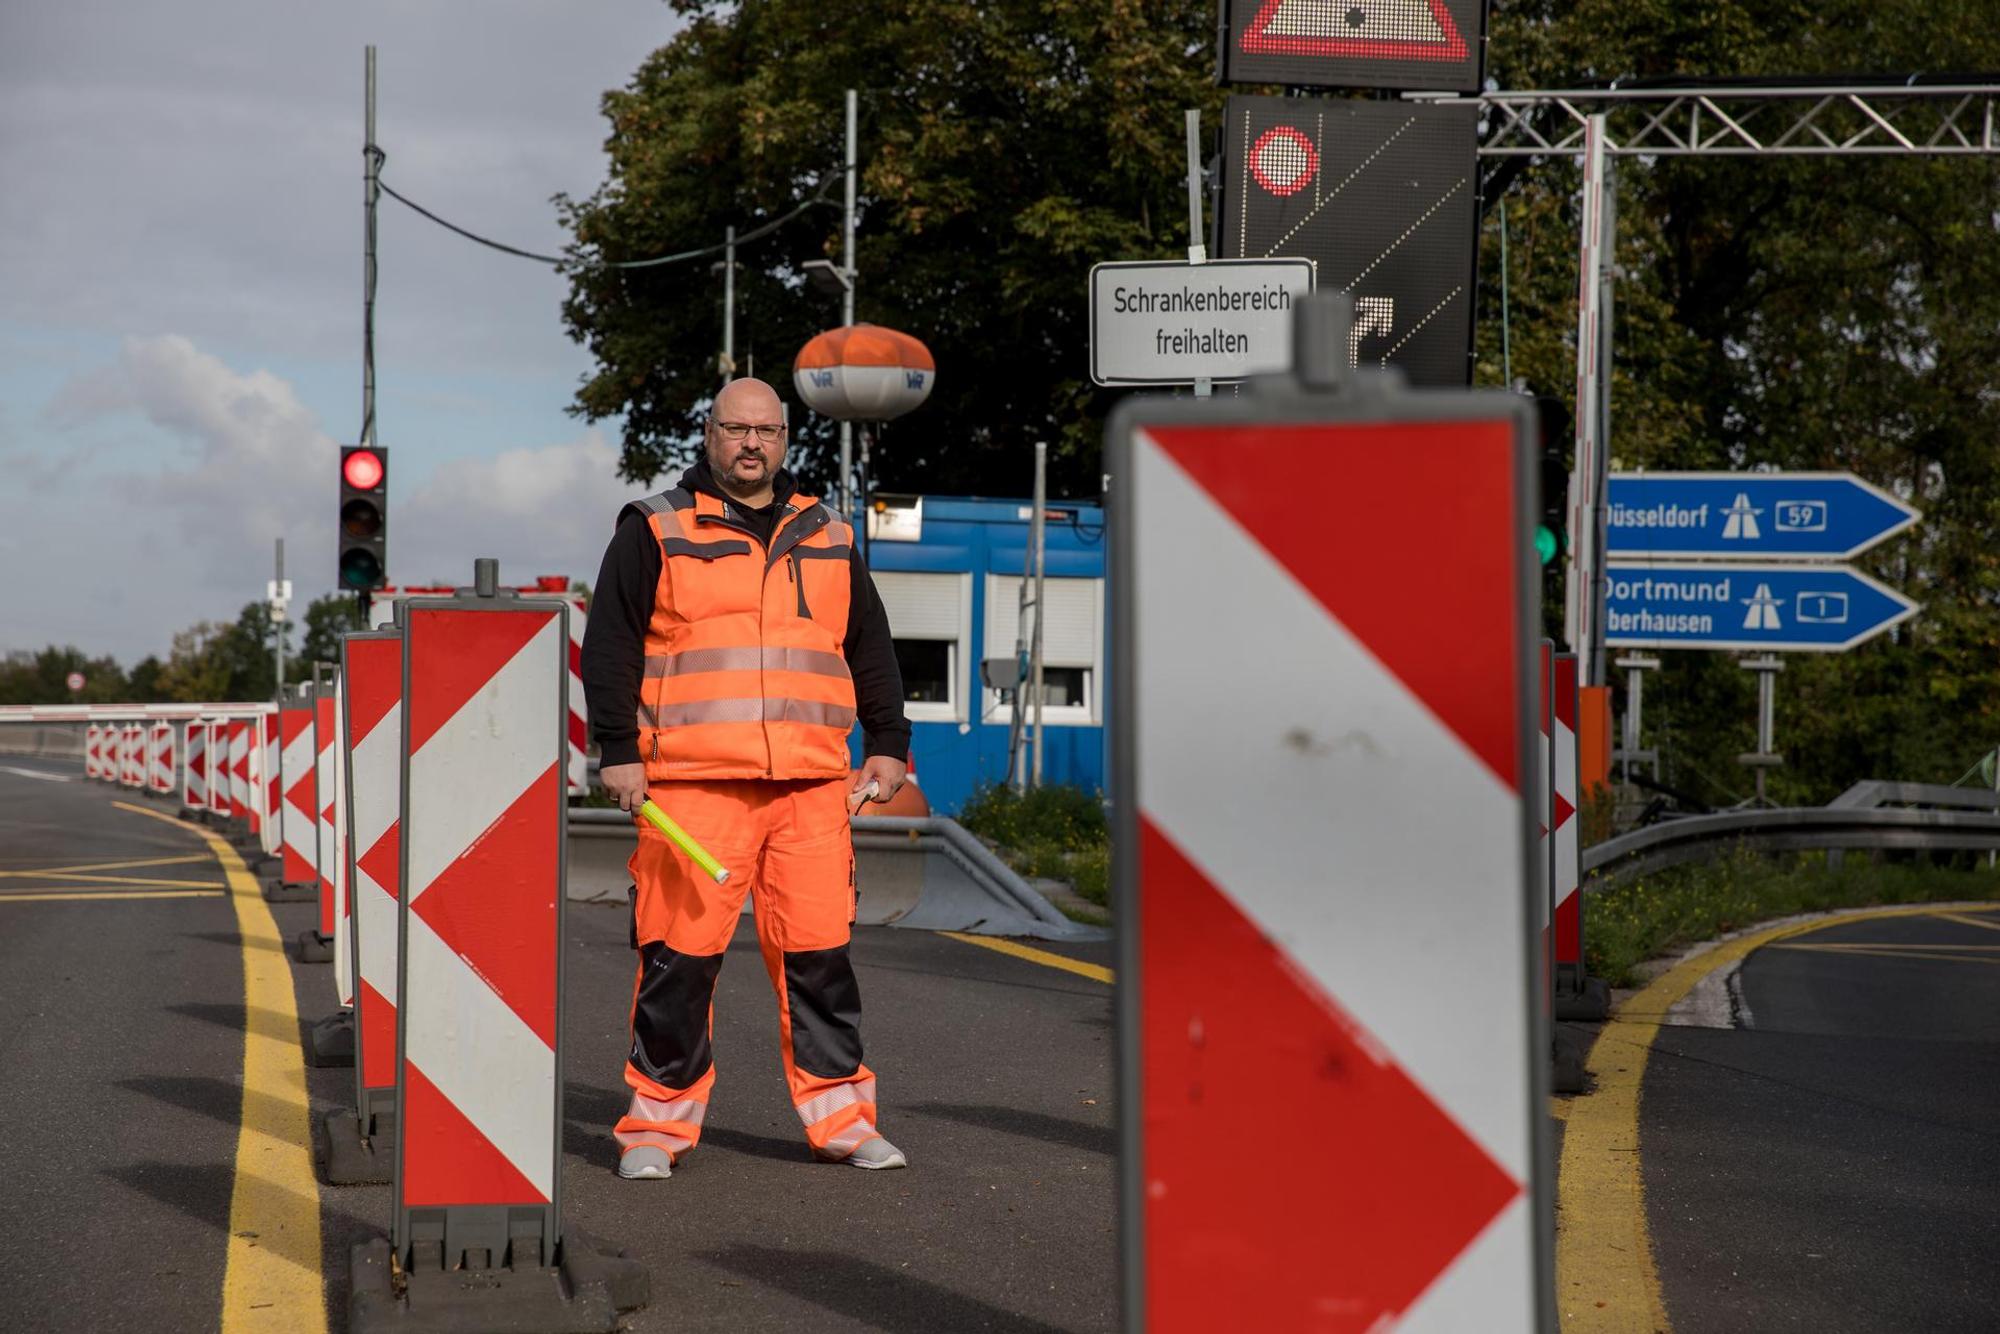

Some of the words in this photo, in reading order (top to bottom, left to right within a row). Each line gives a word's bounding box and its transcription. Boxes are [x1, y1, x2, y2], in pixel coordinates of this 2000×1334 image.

[1114, 284, 1290, 313] Schrankenbereich
[1156, 327, 1248, 354] freihalten
[1788, 506, 1813, 526] 59
[1608, 607, 1713, 633] berhausen
